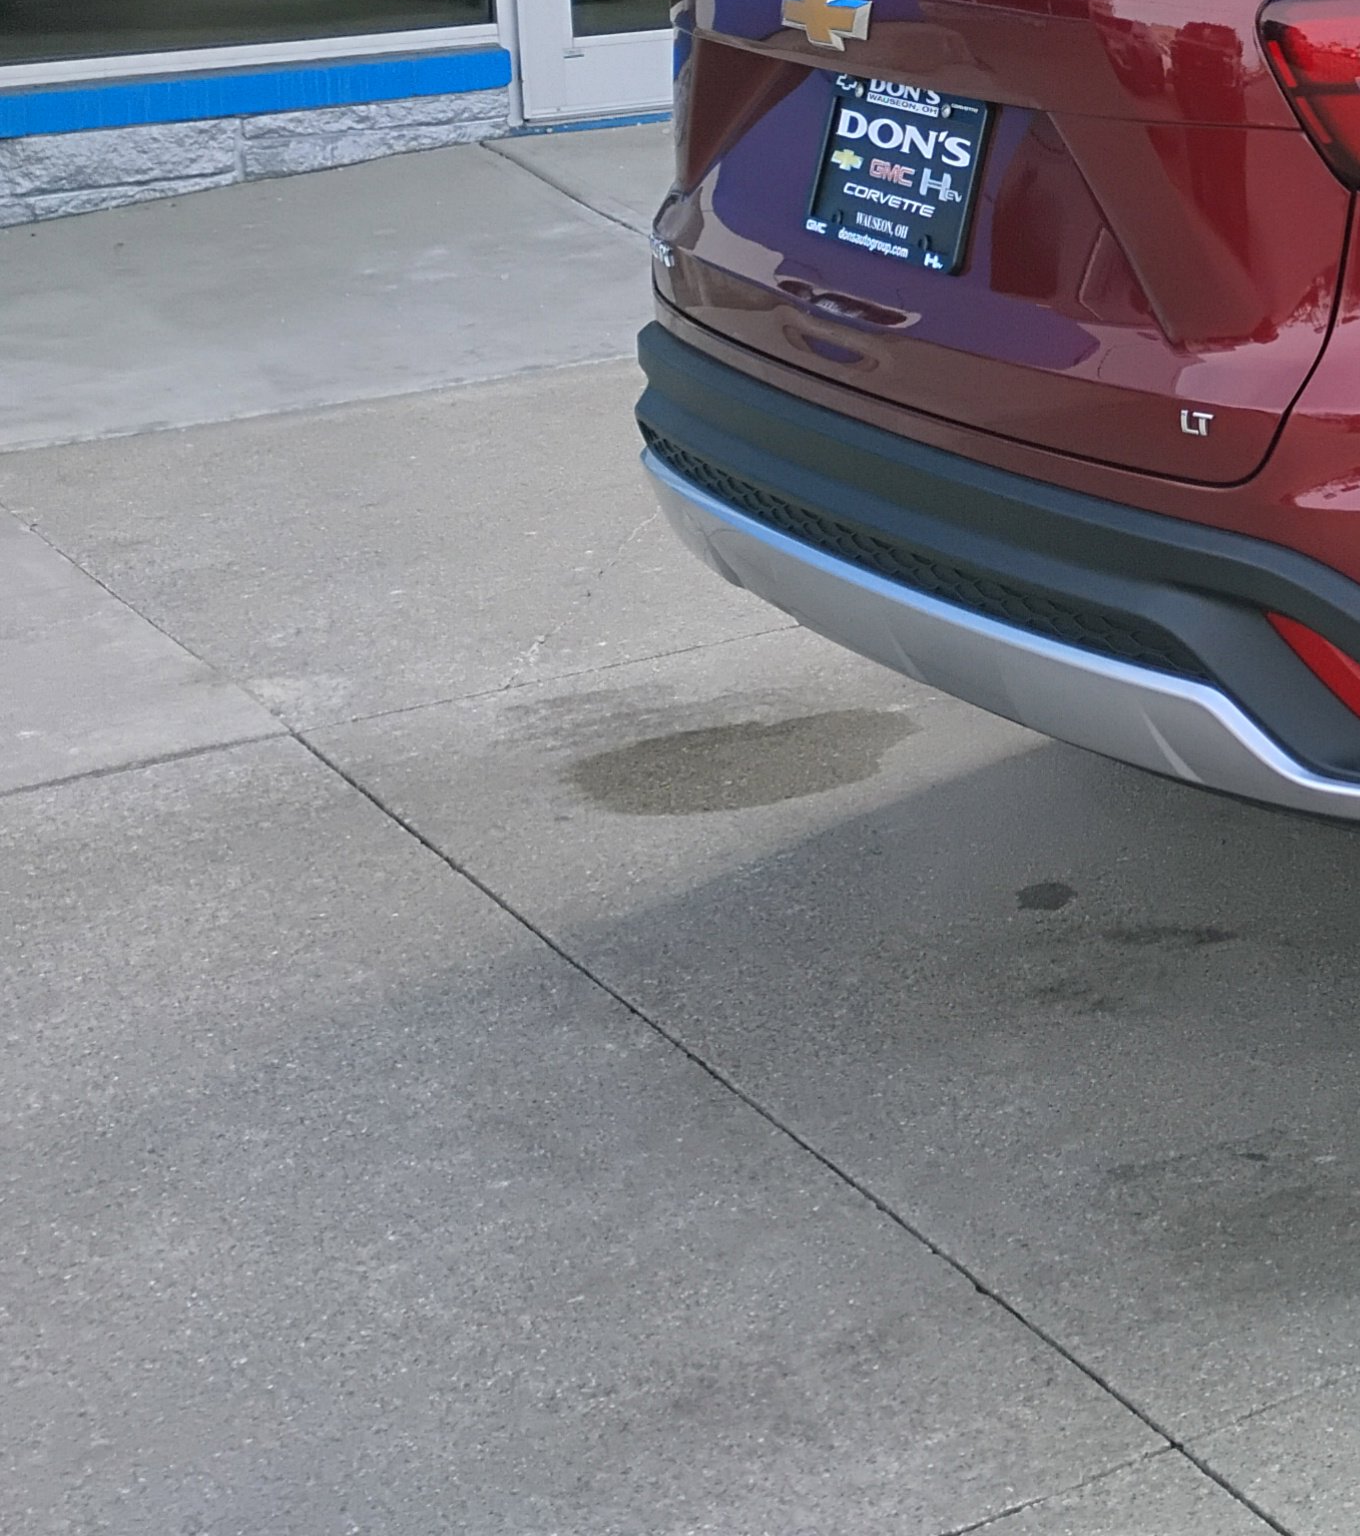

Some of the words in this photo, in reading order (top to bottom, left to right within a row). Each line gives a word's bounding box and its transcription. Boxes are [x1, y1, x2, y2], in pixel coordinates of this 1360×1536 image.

[836, 108, 971, 167] DON'S
[869, 158, 915, 187] GMC
[843, 182, 936, 218] CORVETTE
[855, 211, 894, 237] WAUSEON,
[894, 223, 909, 239] OH
[1180, 409, 1215, 436] LT
